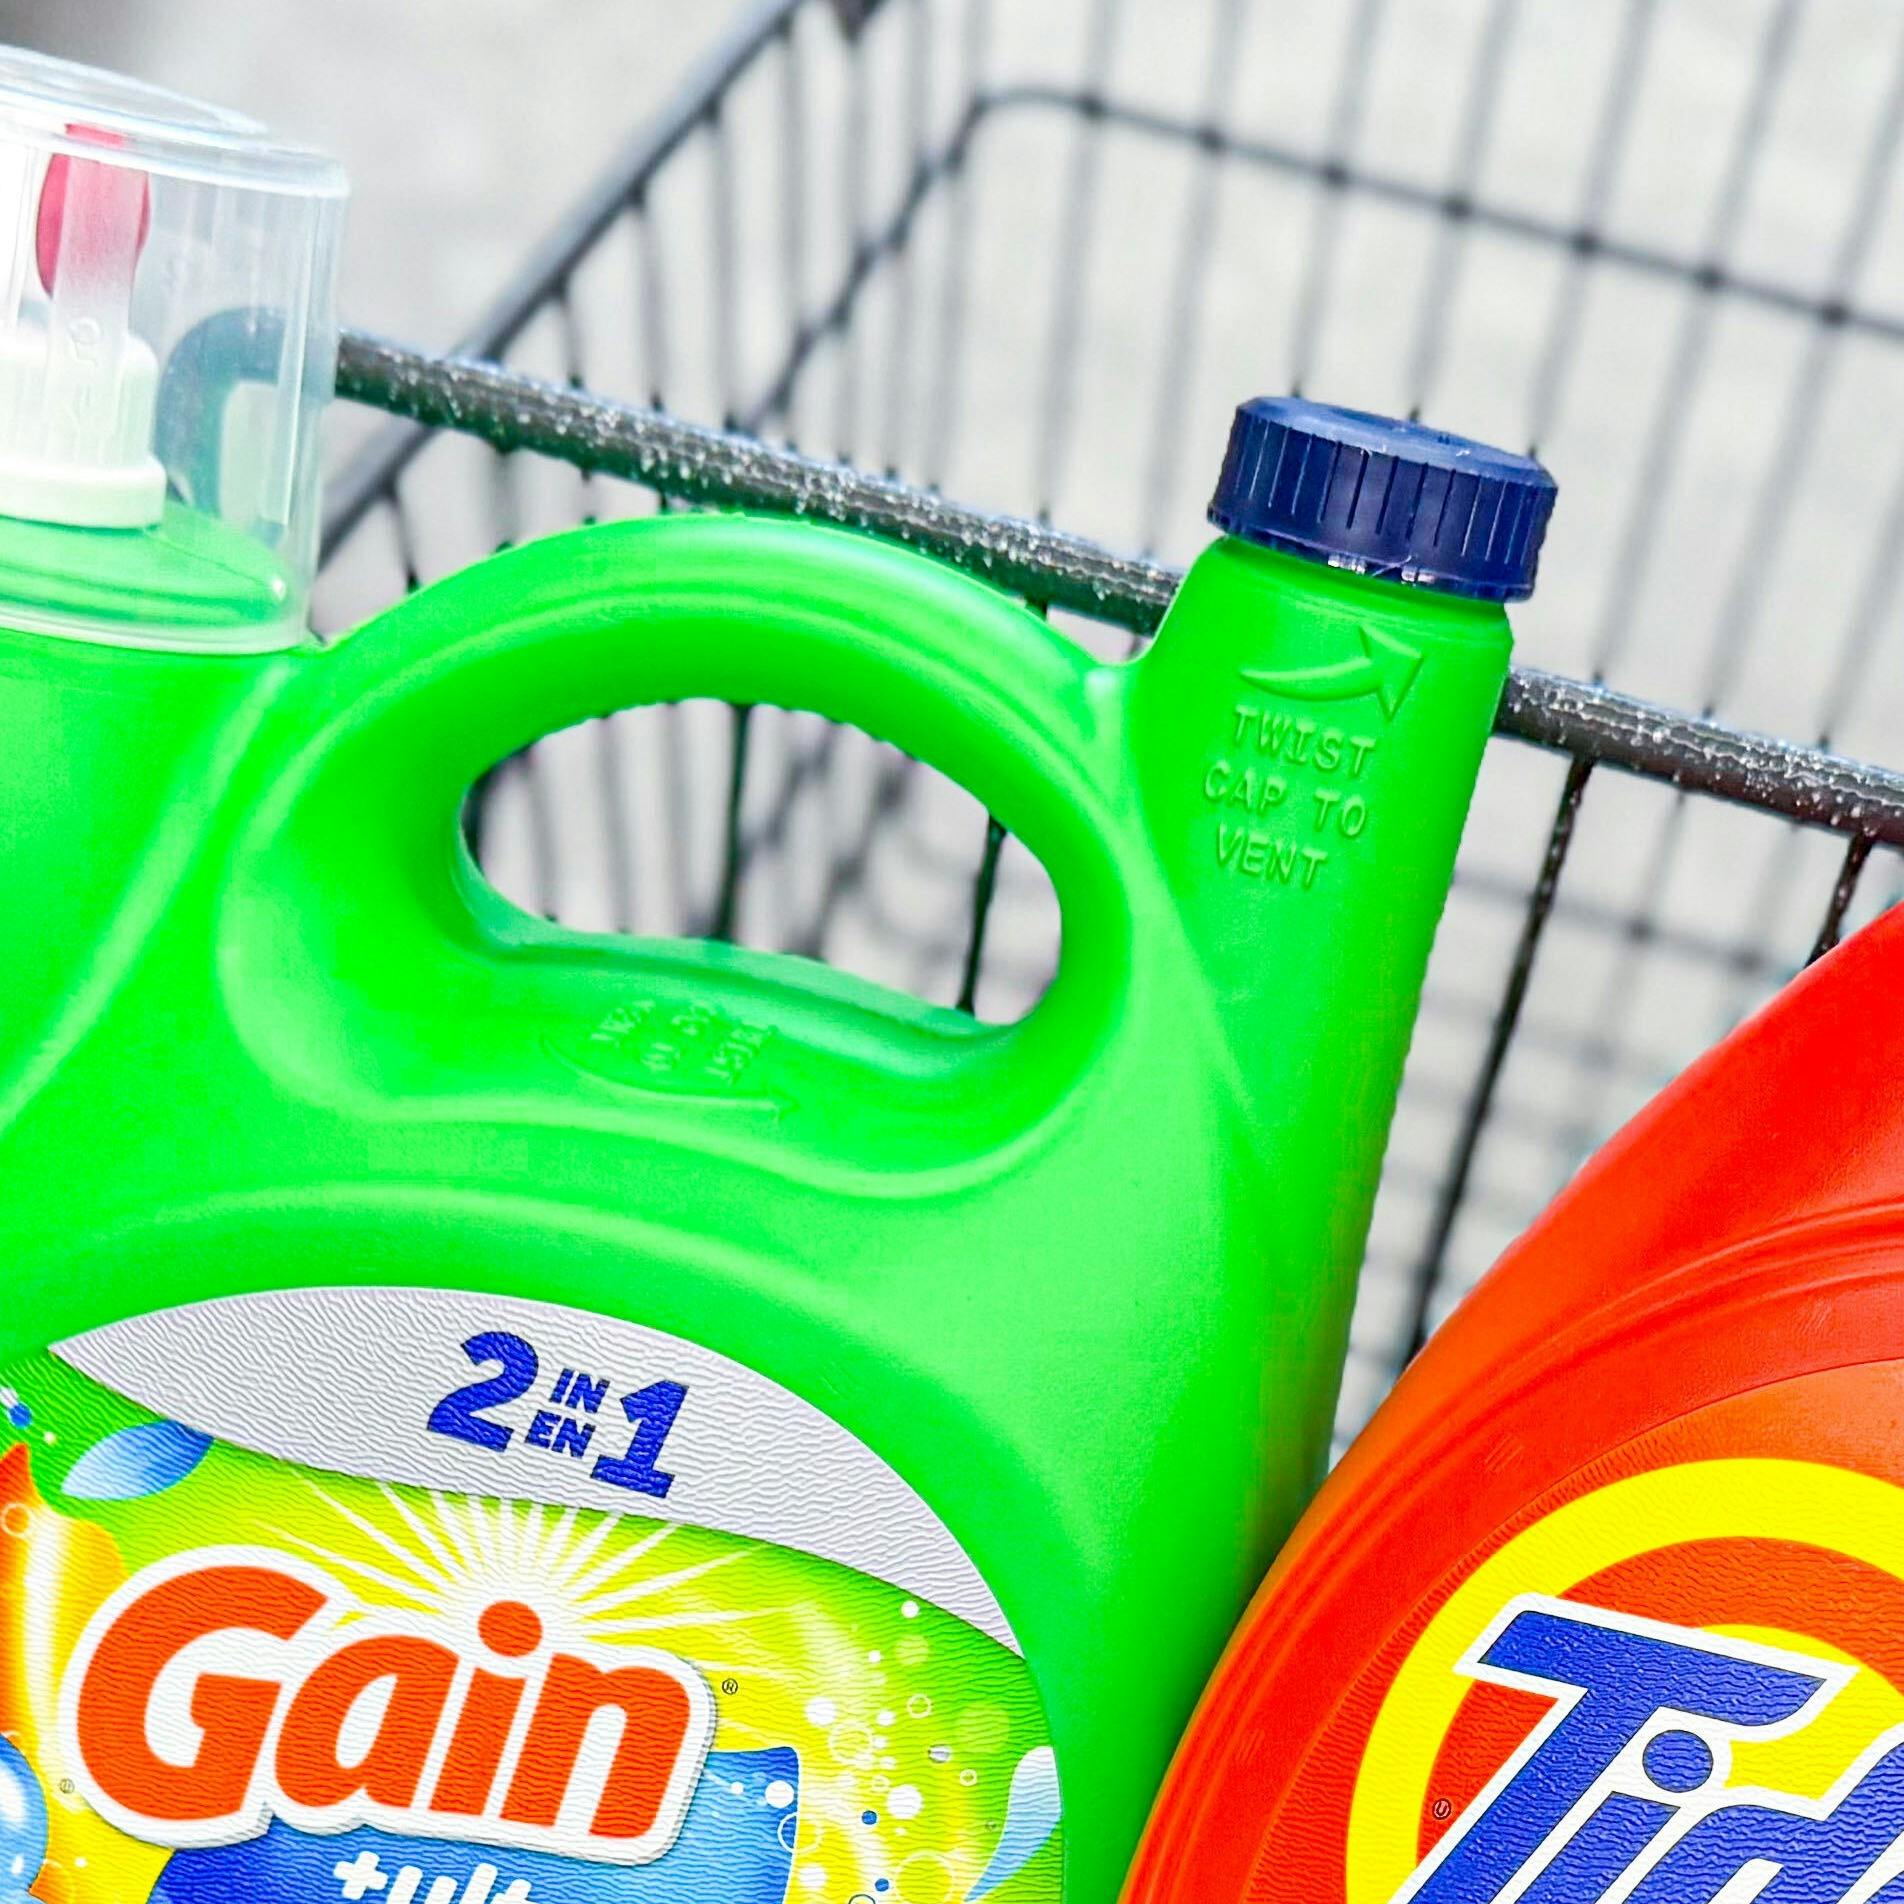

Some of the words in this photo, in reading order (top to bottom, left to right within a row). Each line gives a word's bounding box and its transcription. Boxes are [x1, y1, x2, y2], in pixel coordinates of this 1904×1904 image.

[1233, 705, 1376, 778] TWIST
[1204, 760, 1287, 817] CAP
[1315, 789, 1368, 839] TO
[1215, 825, 1328, 890] VENT
[427, 1331, 539, 1453] 2
[549, 1368, 611, 1414] IN
[525, 1410, 597, 1460] EN
[590, 1380, 690, 1499] 1
[75, 1563, 693, 1839] Gain
